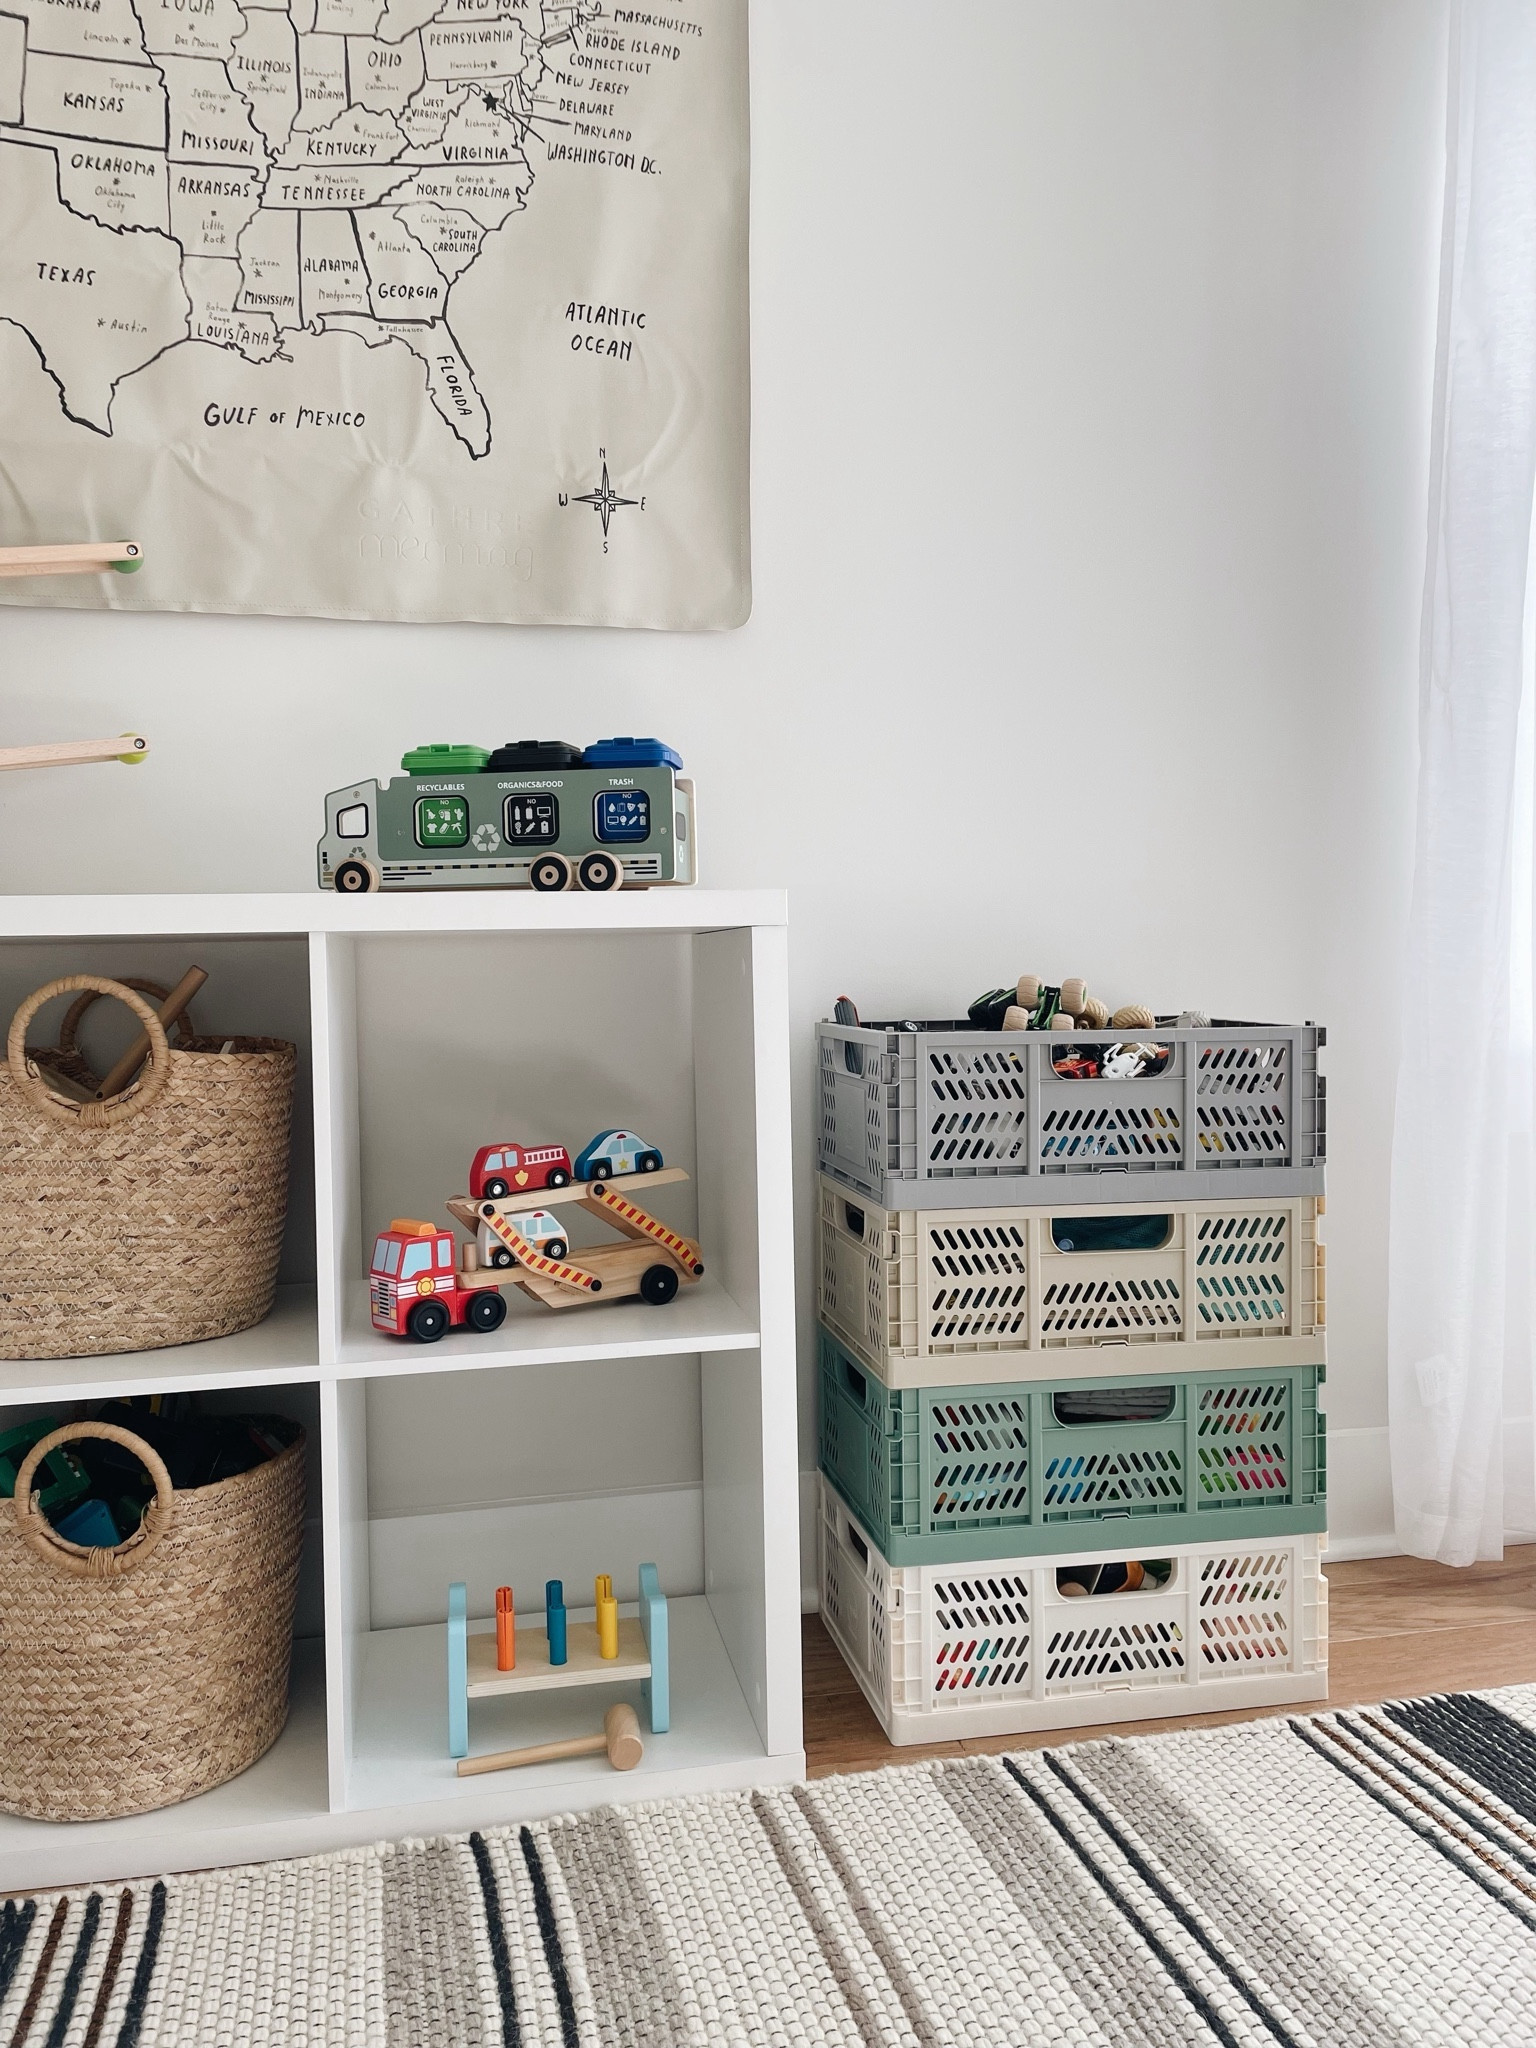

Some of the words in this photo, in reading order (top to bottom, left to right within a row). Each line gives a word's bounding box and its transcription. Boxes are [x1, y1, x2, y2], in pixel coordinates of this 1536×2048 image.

[614, 9, 703, 37] MASSACHUSETTS
[84, 30, 119, 44] Lincoln
[174, 34, 188, 46] Des
[430, 30, 513, 46] PENNSYLVANIA
[585, 33, 625, 51] RHODE
[631, 40, 681, 61] ISLAND
[237, 55, 292, 74] ILLINOIS
[367, 51, 402, 68] OHIO
[569, 52, 651, 75] CONNECTICUT
[109, 77, 141, 92] Topeka
[247, 80, 287, 96] Springfield
[556, 71, 584, 88] NEW
[589, 78, 630, 95] JERSEY
[63, 91, 125, 113] KANSAS
[304, 87, 345, 101] INDIANA
[423, 97, 445, 108] WEST
[559, 99, 615, 117] DELAWARE
[411, 108, 447, 121] VIRGINIA
[465, 118, 501, 128] Richmond
[363, 129, 400, 141] Frankfort
[574, 122, 632, 143] MARYLAND
[182, 130, 255, 156] MISSOURI
[306, 141, 377, 158] KENTUCKY
[442, 146, 509, 161] VIRGINIA
[547, 142, 636, 171] WASHINGTON
[71, 153, 156, 177] OKLAHOMA
[177, 177, 251, 198] ARKANSAS
[455, 175, 485, 186] Raleigh
[94, 186, 136, 200] Oklahoma
[282, 185, 366, 201] TENNESSEE
[416, 184, 452, 197] NORTH
[457, 185, 511, 199] CAROLINA
[106, 200, 125, 213] City
[202, 219, 225, 231] Little
[203, 232, 226, 245] Rock
[448, 228, 478, 240] SOUTH
[377, 241, 411, 253] Atlanta
[432, 242, 476, 253] CAROLINA
[303, 257, 359, 273] ALABAMA
[37, 262, 96, 286] TEXAS
[244, 290, 295, 307] MISSISSIPPI
[318, 287, 363, 304] Montgomery
[378, 282, 438, 299] GEORGIA
[205, 301, 228, 312] Baton
[208, 312, 230, 324] Rouge
[565, 301, 646, 329] ATLANTIC
[110, 318, 148, 334] Austin
[197, 322, 270, 346] LOUISIANA
[571, 334, 632, 361] OCEAN
[436, 355, 473, 416] FLORIDA
[204, 402, 258, 427] GULF
[296, 405, 366, 428] MEXICO
[599, 447, 606, 459] N
[558, 493, 568, 507] W
[640, 496, 647, 511] E
[603, 541, 609, 554] S
[416, 783, 465, 792] RECYCLABLES
[497, 780, 564, 789] ORGANICS&FOOD
[608, 778, 634, 786] TRASH
